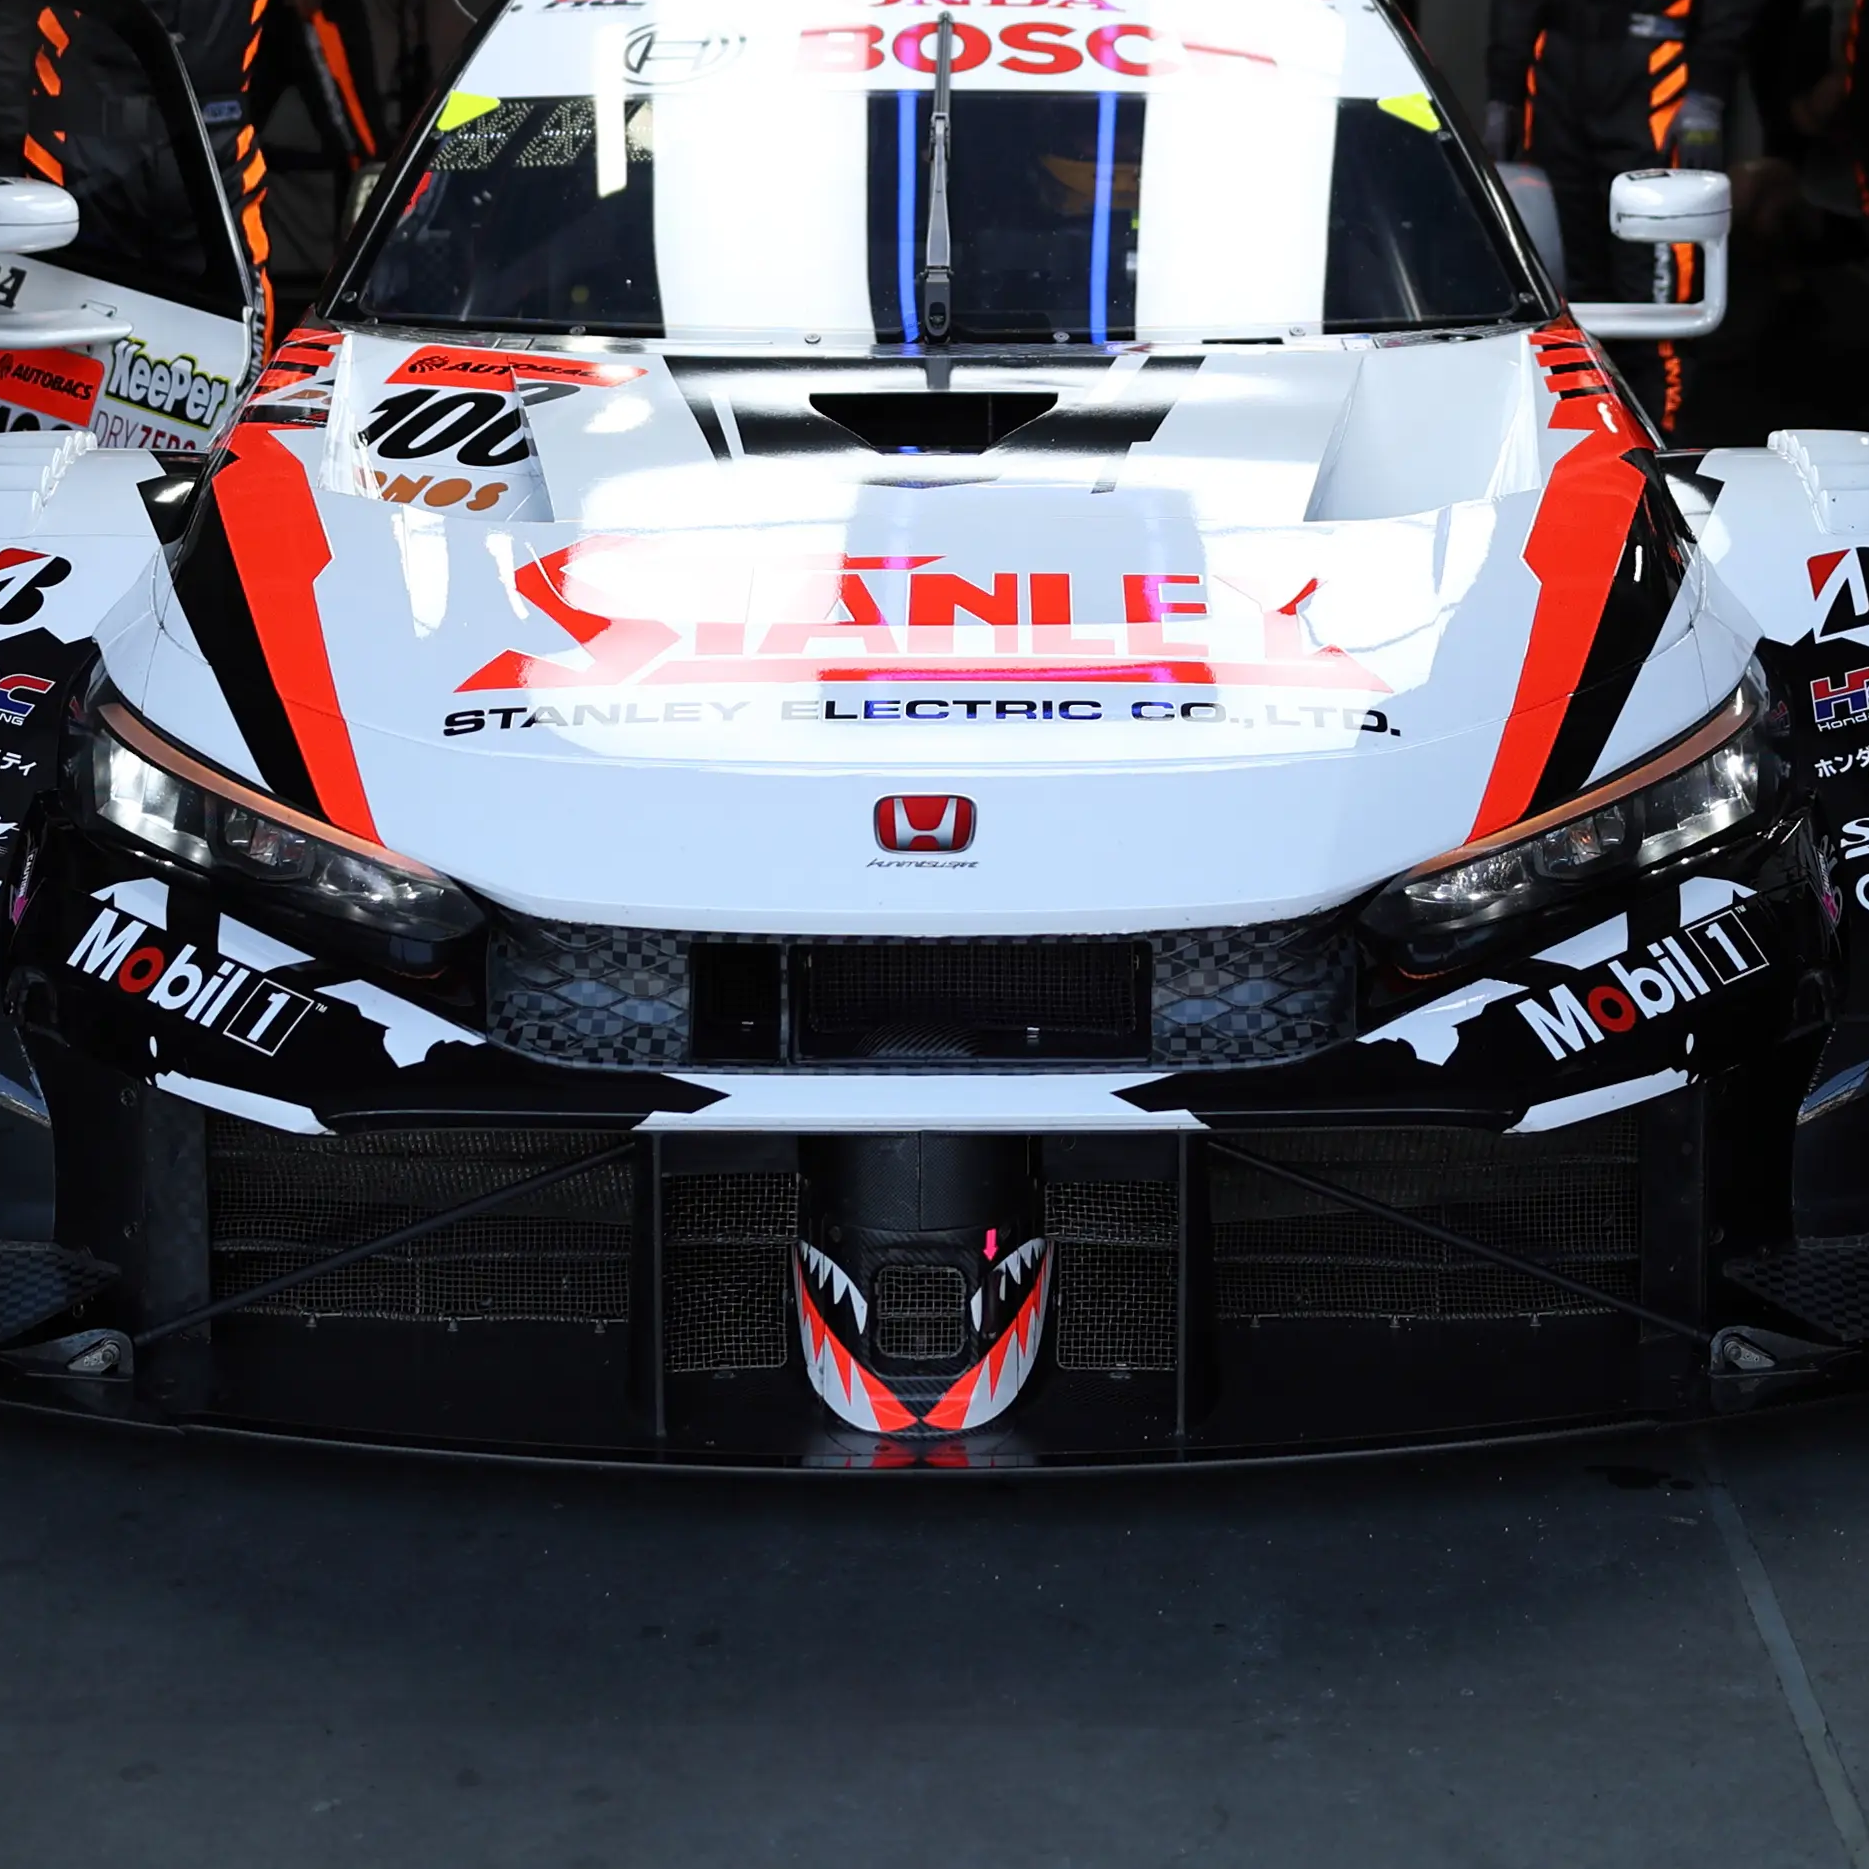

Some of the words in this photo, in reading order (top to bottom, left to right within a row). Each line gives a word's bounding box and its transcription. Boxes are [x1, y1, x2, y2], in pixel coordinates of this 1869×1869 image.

[795, 19, 1184, 77] BOSC
[10, 362, 94, 401] AUTOBACS
[107, 336, 229, 428] KeePer
[452, 532, 1396, 695] STANLEY
[442, 699, 750, 737] STANLEY
[780, 698, 1104, 724] ELECTRIC
[66, 907, 252, 1029] Mobil
[1515, 935, 1711, 1062] Mobil
